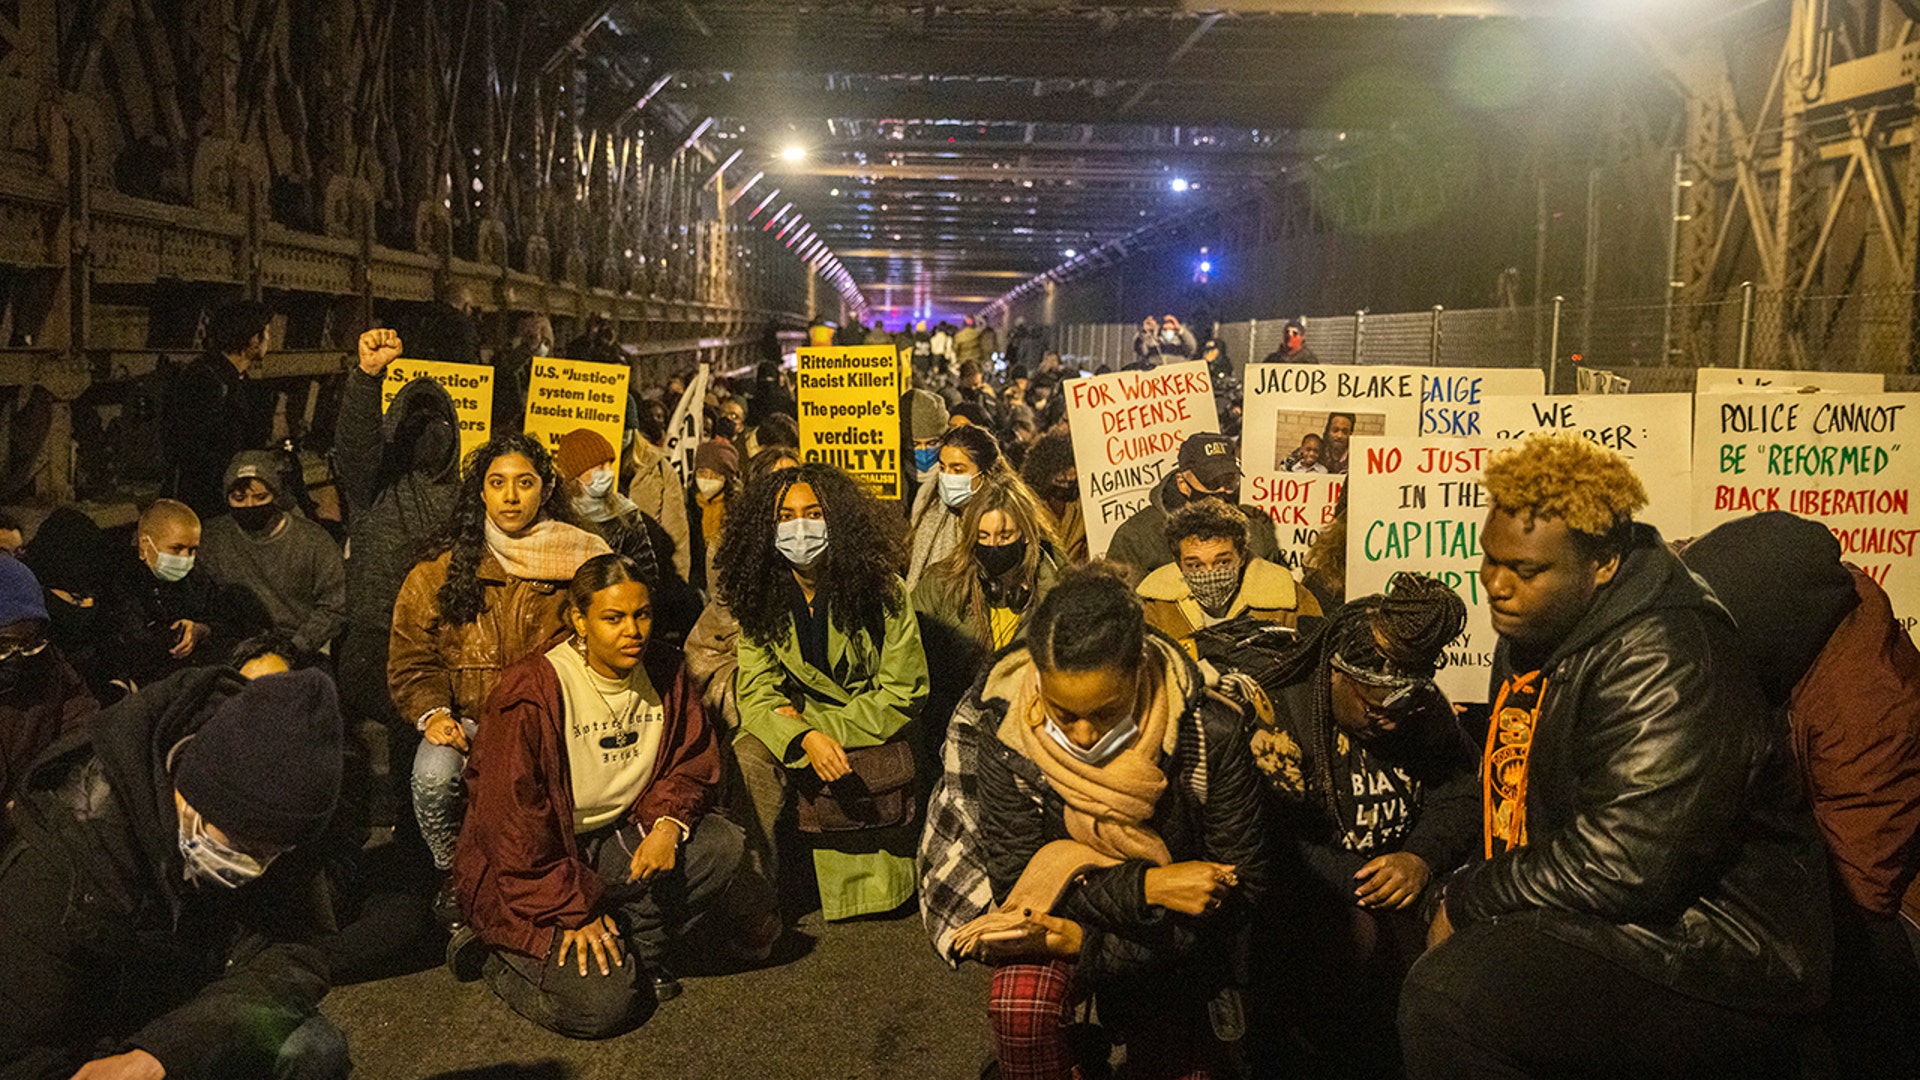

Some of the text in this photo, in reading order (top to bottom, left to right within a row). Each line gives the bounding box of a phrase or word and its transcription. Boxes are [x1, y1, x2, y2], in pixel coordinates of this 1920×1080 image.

[535, 365, 560, 379] U.S.
[801, 354, 893, 370] Rittenhouse:
[801, 371, 894, 388] Racist Killer!
[1072, 371, 1210, 409] FOR WORKERS
[1254, 368, 1412, 399] JACOB BLAKE
[539, 386, 615, 404] system lets
[530, 402, 621, 424] fascist killers
[802, 401, 895, 419] The people’s
[1101, 398, 1191, 435] DEFENSE
[1532, 402, 1577, 428] WE
[1721, 403, 1906, 434] POLICE CANNOT
[814, 427, 883, 445] verdict:
[1106, 429, 1185, 466] GUARDS
[1204, 442, 1228, 456] CAT
[804, 449, 895, 470] GUILTY!
[1367, 447, 1489, 475] NO JUST
[1720, 443, 1747, 475] BE
[1090, 458, 1165, 498] AGAINST
[1252, 476, 1317, 503] SHOT
[1398, 481, 1489, 510] IN THE
[1715, 484, 1909, 517] BLACK LIBERATION
